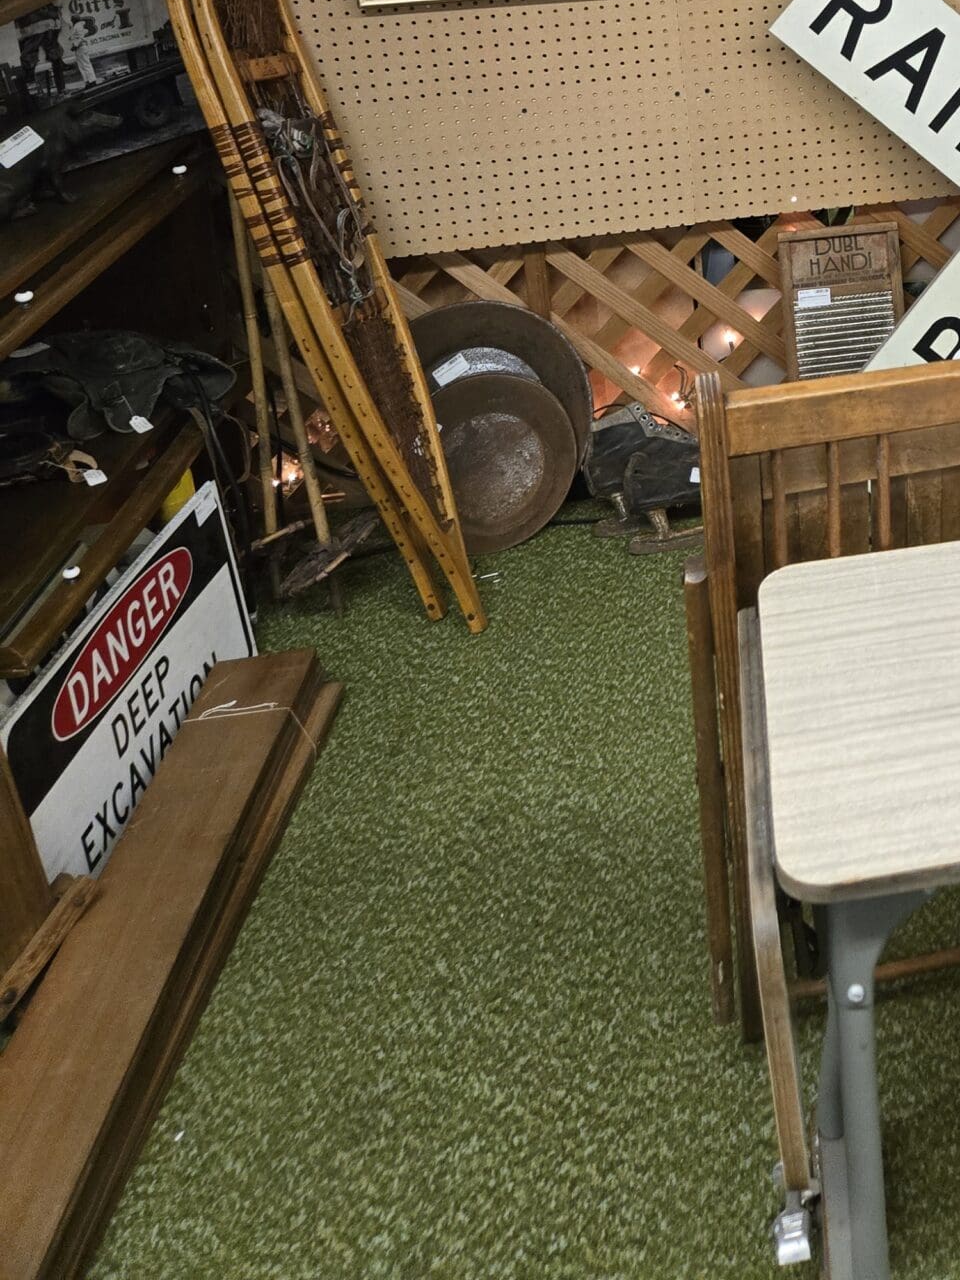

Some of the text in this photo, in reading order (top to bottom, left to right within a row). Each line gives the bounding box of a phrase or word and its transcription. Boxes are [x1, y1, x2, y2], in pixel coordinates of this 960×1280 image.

[815, 235, 865, 256] DUBL
[65, 561, 182, 726] DANGER
[111, 654, 171, 759] DEEP
